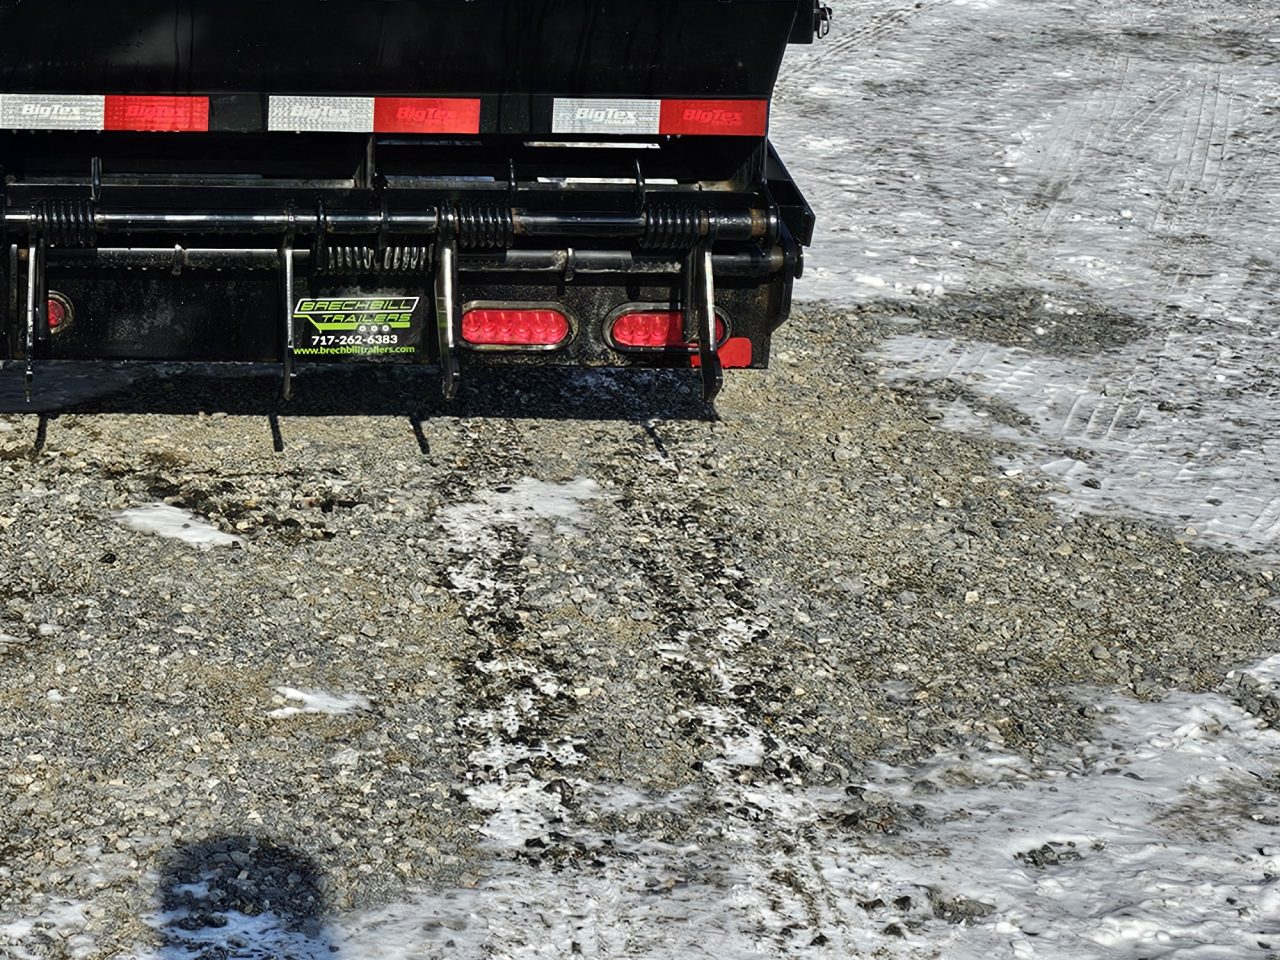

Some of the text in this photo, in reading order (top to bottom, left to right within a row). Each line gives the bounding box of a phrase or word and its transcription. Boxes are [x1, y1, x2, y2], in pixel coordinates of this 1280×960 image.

[22, 104, 81, 119] BigTex
[575, 107, 639, 123] BigTex
[683, 108, 744, 124] BigTex
[300, 300, 412, 311] BRECHBILL
[322, 313, 413, 323] TRAILERS
[311, 335, 398, 346] 717-262-6383
[293, 346, 415, 355] www.brechbilltrailers.com
